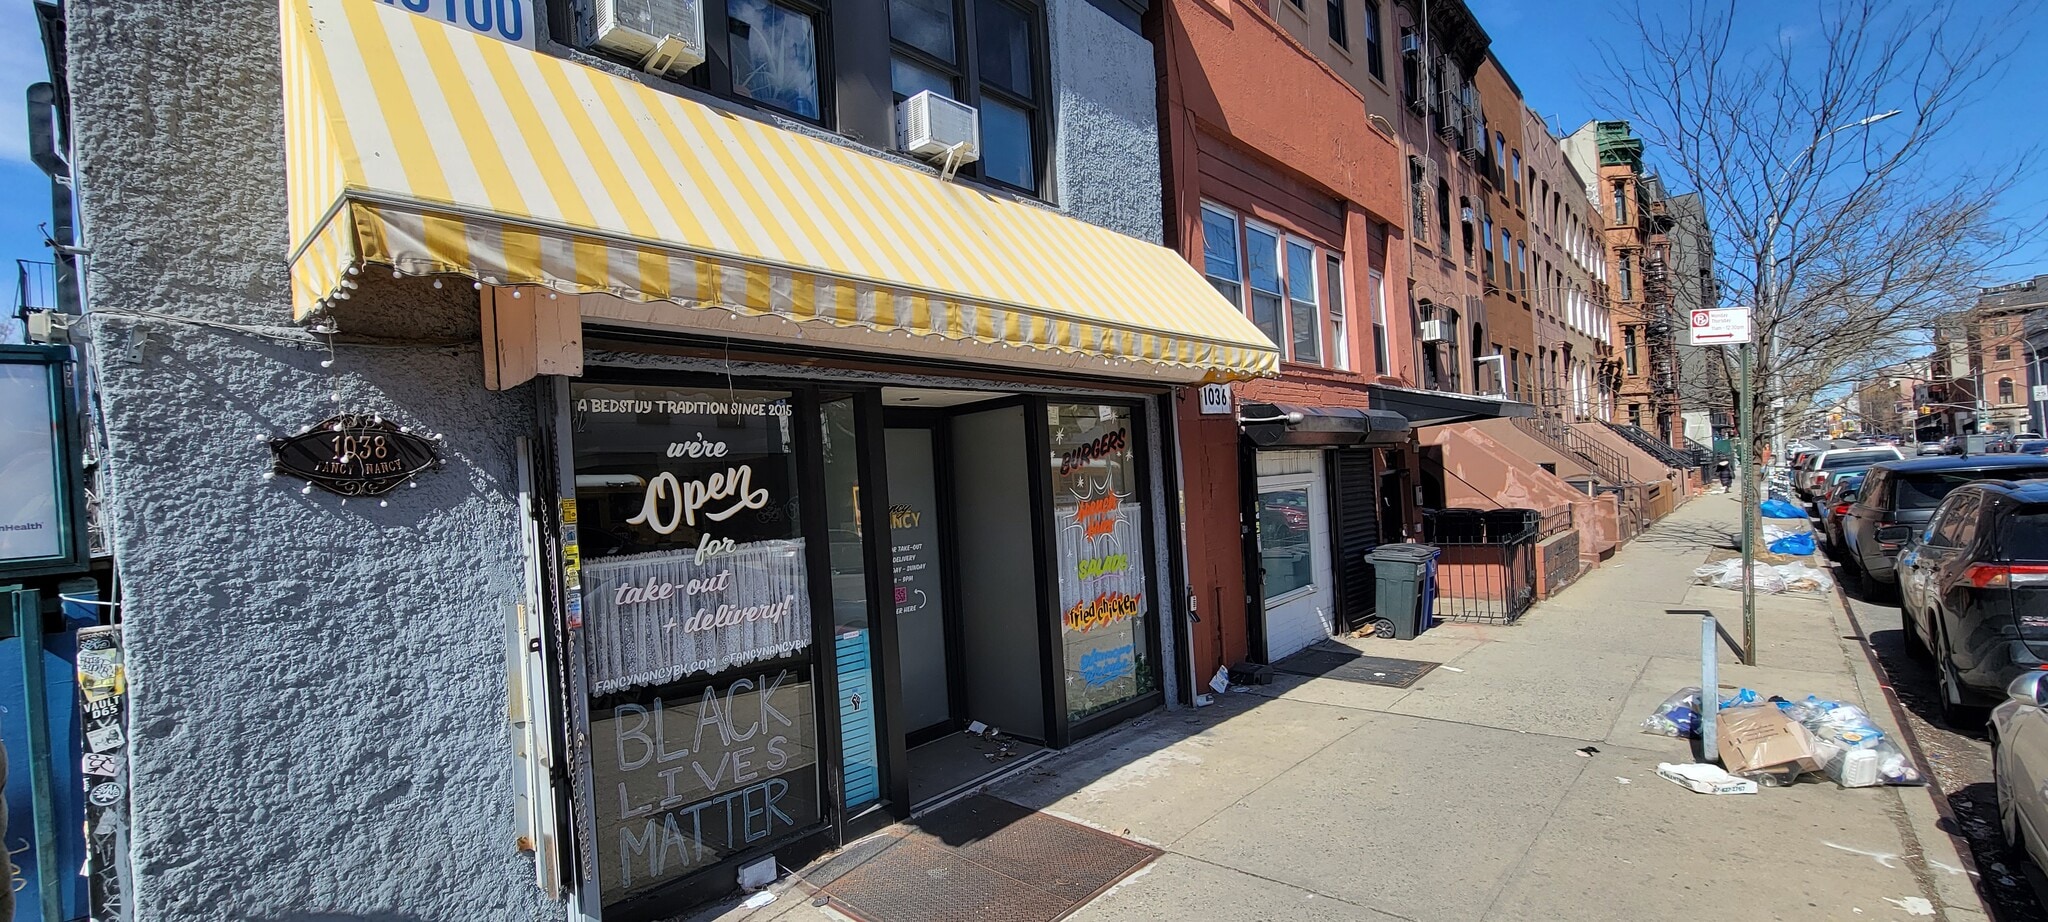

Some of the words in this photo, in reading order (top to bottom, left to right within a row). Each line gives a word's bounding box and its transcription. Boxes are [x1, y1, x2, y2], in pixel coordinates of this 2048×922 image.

[577, 399, 588, 413] A
[591, 399, 654, 415] BEDSTUY
[655, 400, 729, 415] TRADITION
[730, 402, 767, 416] SINCE
[768, 404, 793, 417] 2015
[1203, 387, 1227, 406] 1036
[331, 435, 388, 460] 1038
[666, 432, 729, 459] we're
[1059, 427, 1127, 478] BURGERS
[314, 460, 354, 475] FANCY
[364, 458, 403, 475] NANCY
[626, 464, 769, 535] Open
[694, 533, 737, 567] for
[893, 555, 916, 563] DELIVERY
[898, 543, 923, 552] TAKE-OUT
[906, 563, 927, 572] SUNDAY
[1077, 553, 1128, 581] SALADS
[613, 569, 732, 606] take-out
[662, 619, 679, 635] +
[684, 594, 794, 634] delivery!
[903, 605, 917, 613] HERE
[1069, 600, 1097, 628] fried
[1096, 592, 1137, 622] chicken
[593, 657, 718, 693] FANCYNANCYBK.COM
[721, 639, 809, 665] @FANCYNANCYBK
[83, 695, 120, 714] VAULT
[91, 705, 119, 720] D65
[614, 669, 792, 772] BLACK
[617, 735, 788, 820] LIVES
[619, 777, 795, 889] MATTER
